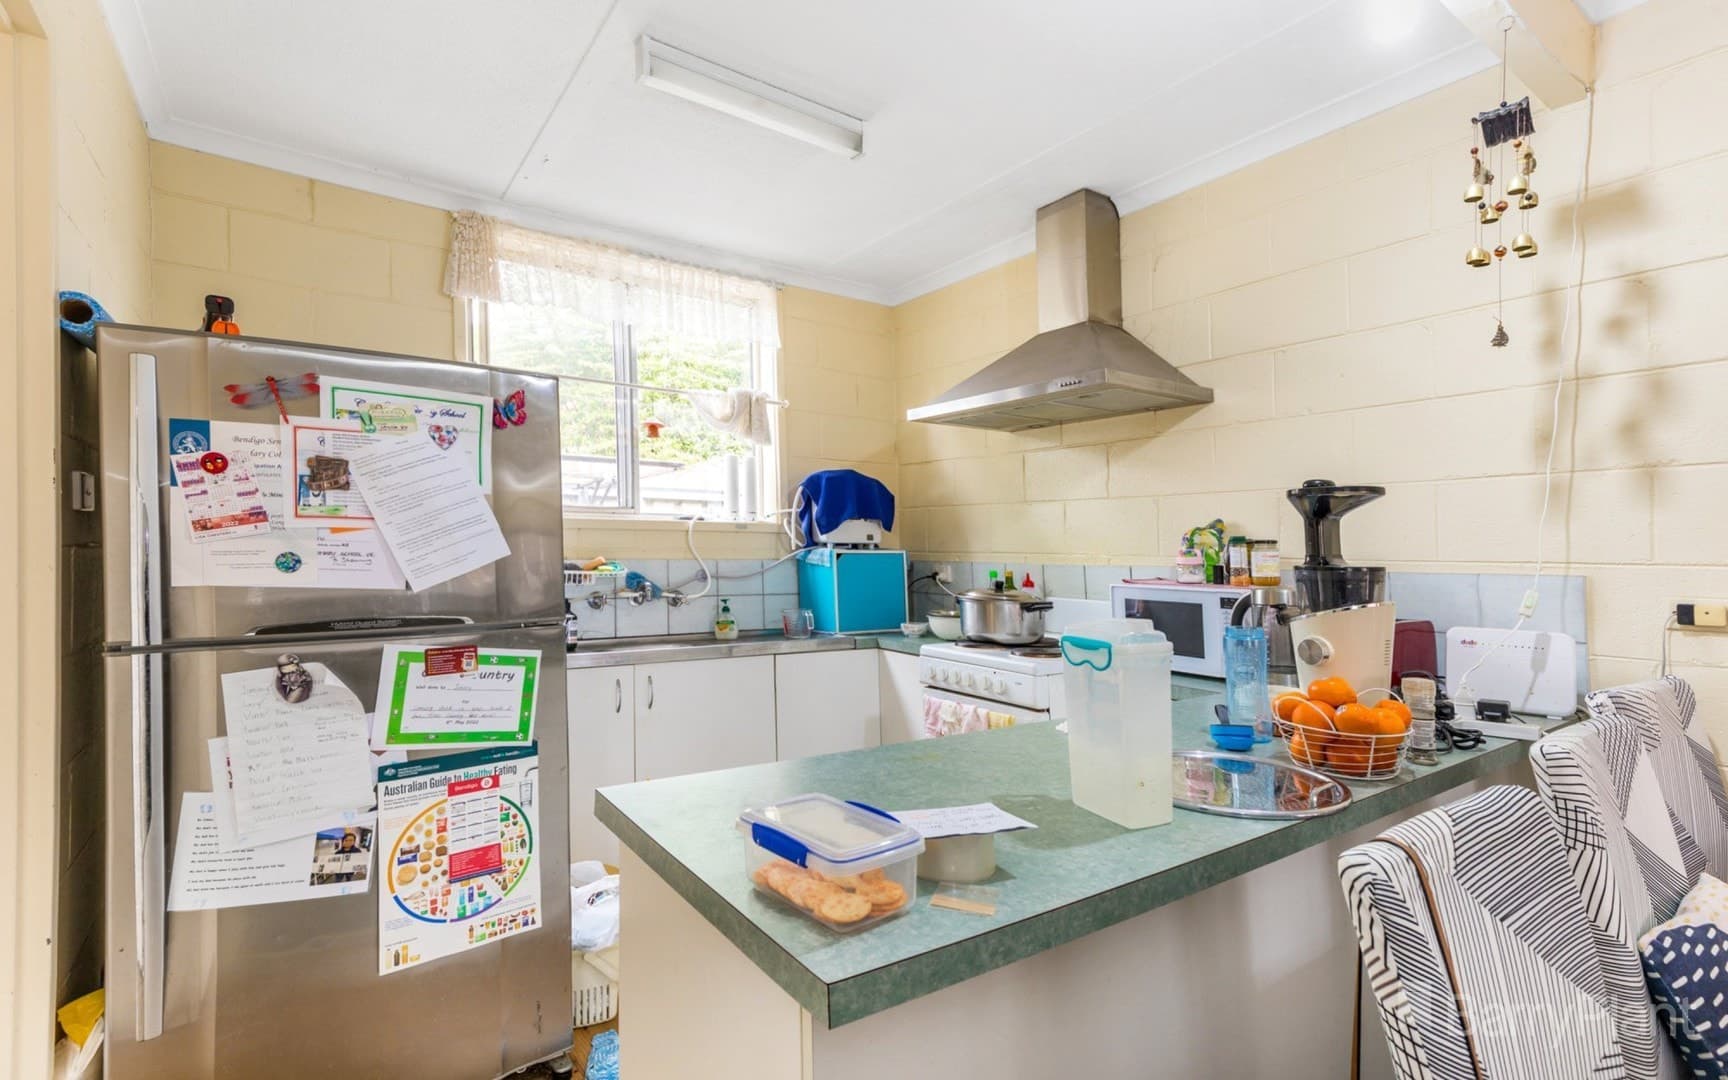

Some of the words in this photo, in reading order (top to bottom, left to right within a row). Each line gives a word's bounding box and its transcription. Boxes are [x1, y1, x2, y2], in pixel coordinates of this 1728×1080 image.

[384, 779, 428, 797] Australian
[429, 774, 453, 789] Guide
[463, 768, 493, 781] Healthy
[493, 763, 518, 777] Eating
